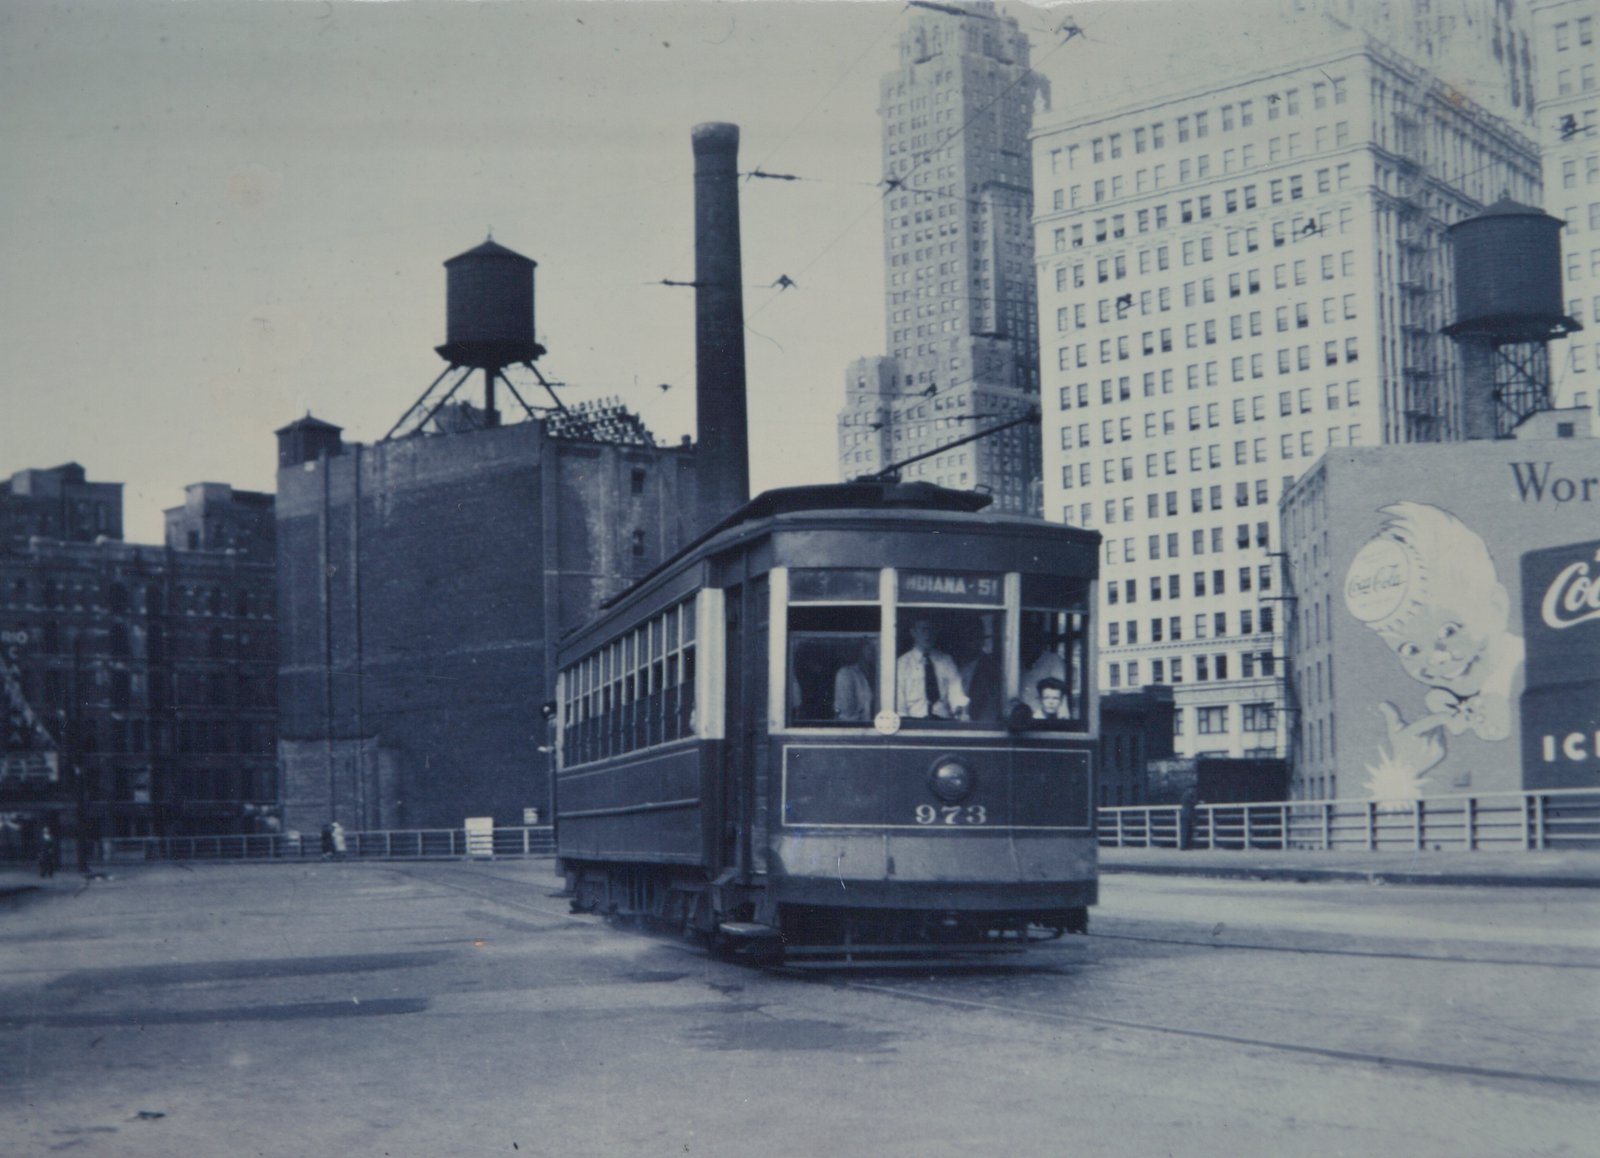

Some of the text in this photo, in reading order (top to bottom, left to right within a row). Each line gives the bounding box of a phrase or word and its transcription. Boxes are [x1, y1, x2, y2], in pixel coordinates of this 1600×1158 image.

[1508, 461, 1600, 502] Wor
[903, 573, 968, 594] NDIANA
[978, 578, 999, 597] 51
[1543, 732, 1600, 762] IC
[915, 804, 986, 825] 973
